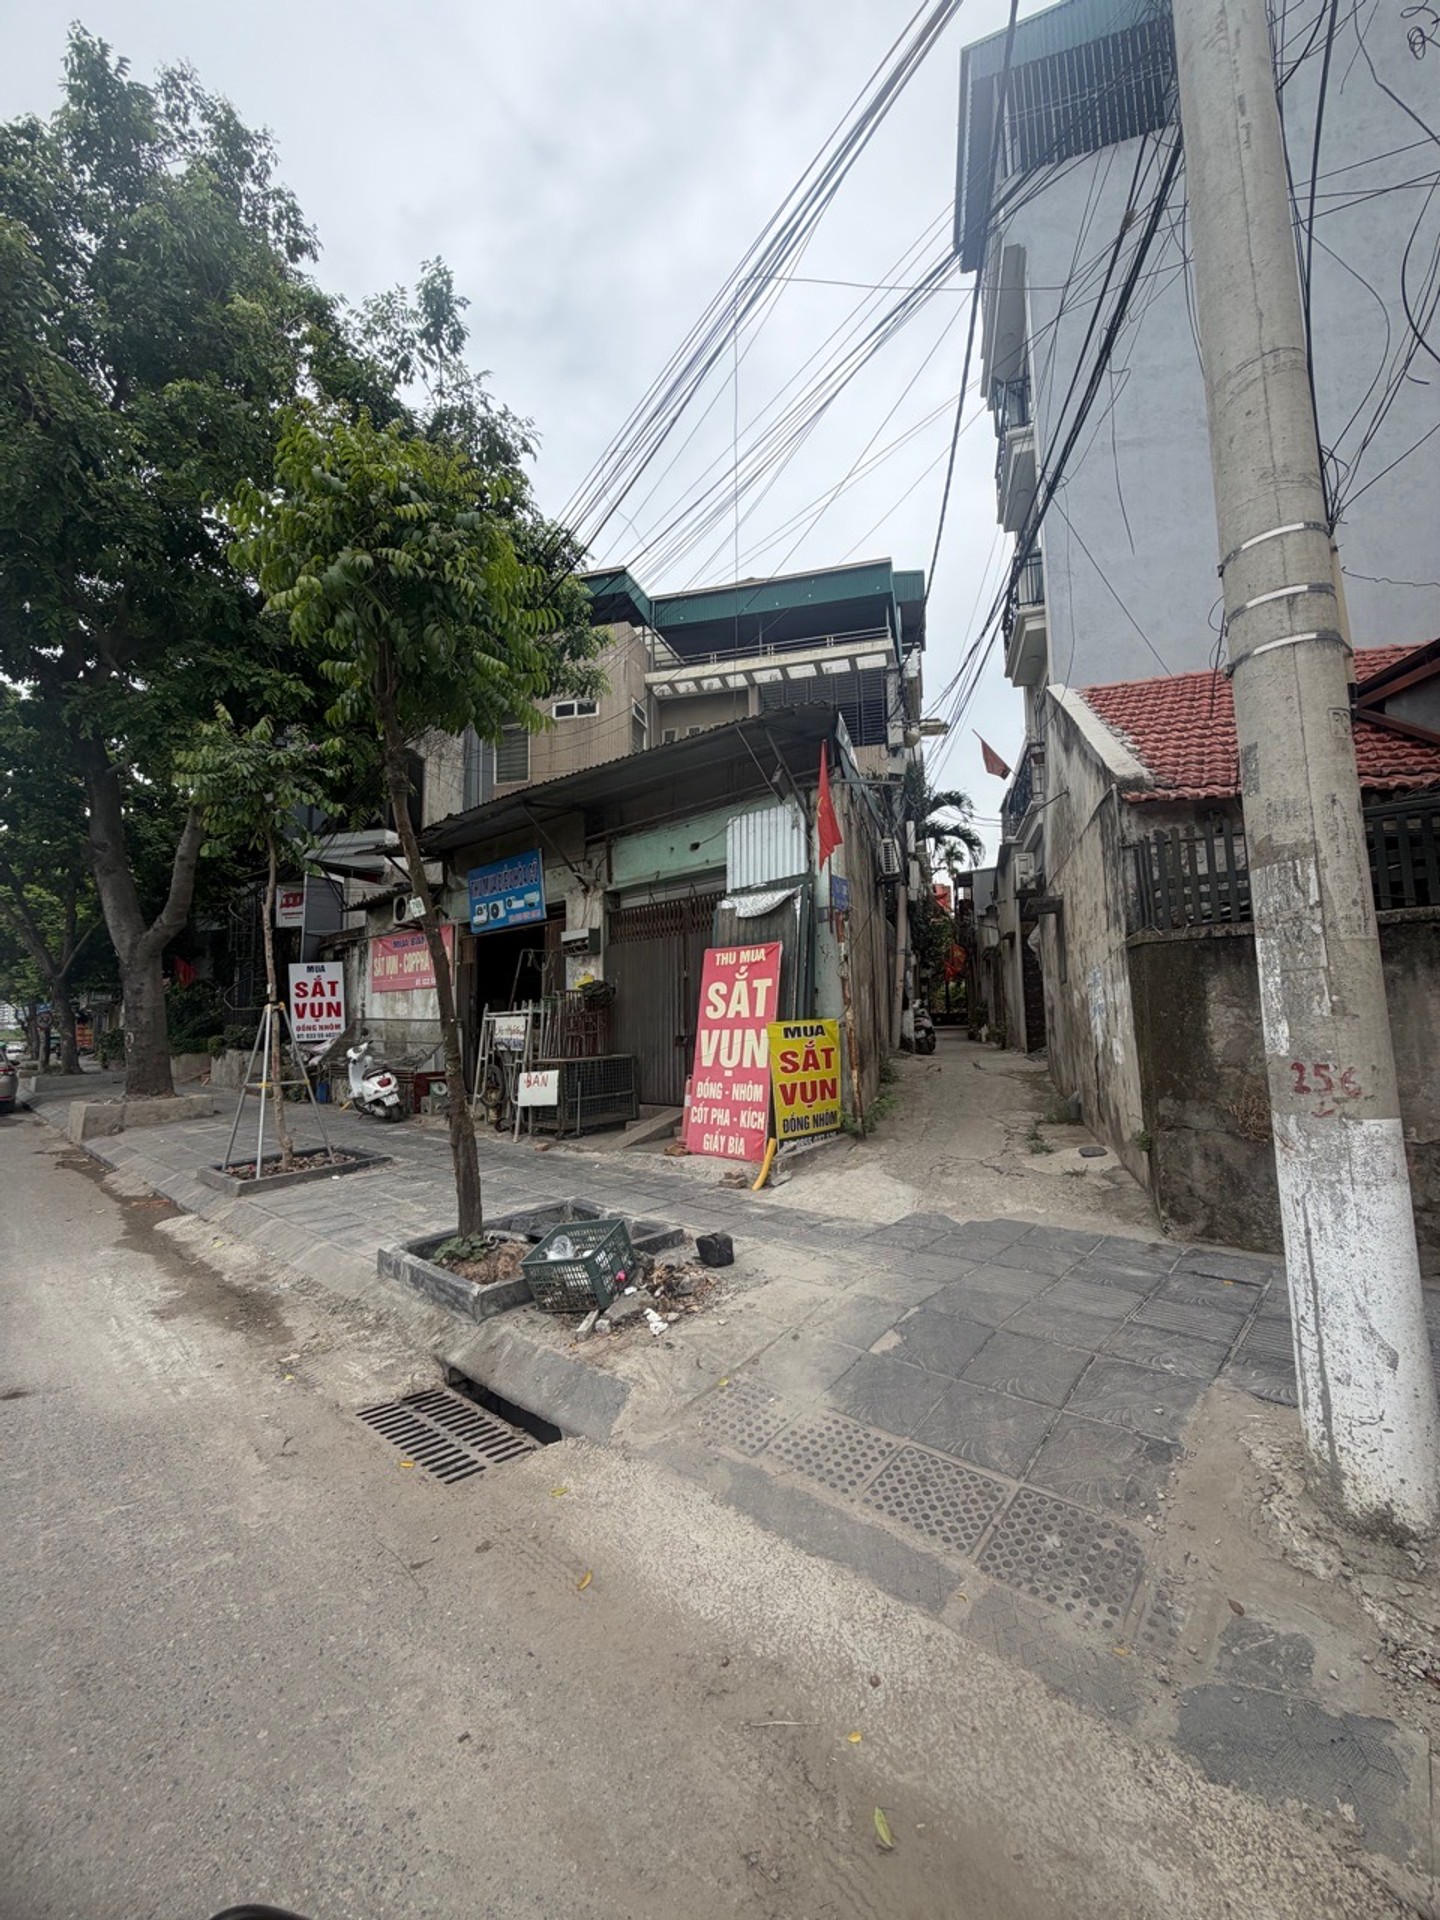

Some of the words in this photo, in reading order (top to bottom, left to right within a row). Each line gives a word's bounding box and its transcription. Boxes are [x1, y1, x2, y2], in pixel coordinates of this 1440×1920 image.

[306, 965, 326, 973] MUA
[715, 952, 737, 966] THU
[740, 948, 767, 963] MUA
[294, 975, 339, 998] SẮT
[705, 965, 773, 1019] SẮT
[294, 1001, 342, 1022] VỤN
[783, 1025, 826, 1038] MUA
[700, 1029, 769, 1077] VỤN
[779, 1040, 835, 1074] SẮT
[731, 1080, 764, 1102] NHÔM
[778, 1078, 837, 1108] VỤN
[691, 1101, 710, 1125] CỐT
[710, 1107, 731, 1126] PHA
[740, 1106, 765, 1130] KÍCH
[703, 1128, 726, 1153] GIẤY
[727, 1132, 746, 1156] BÌA
